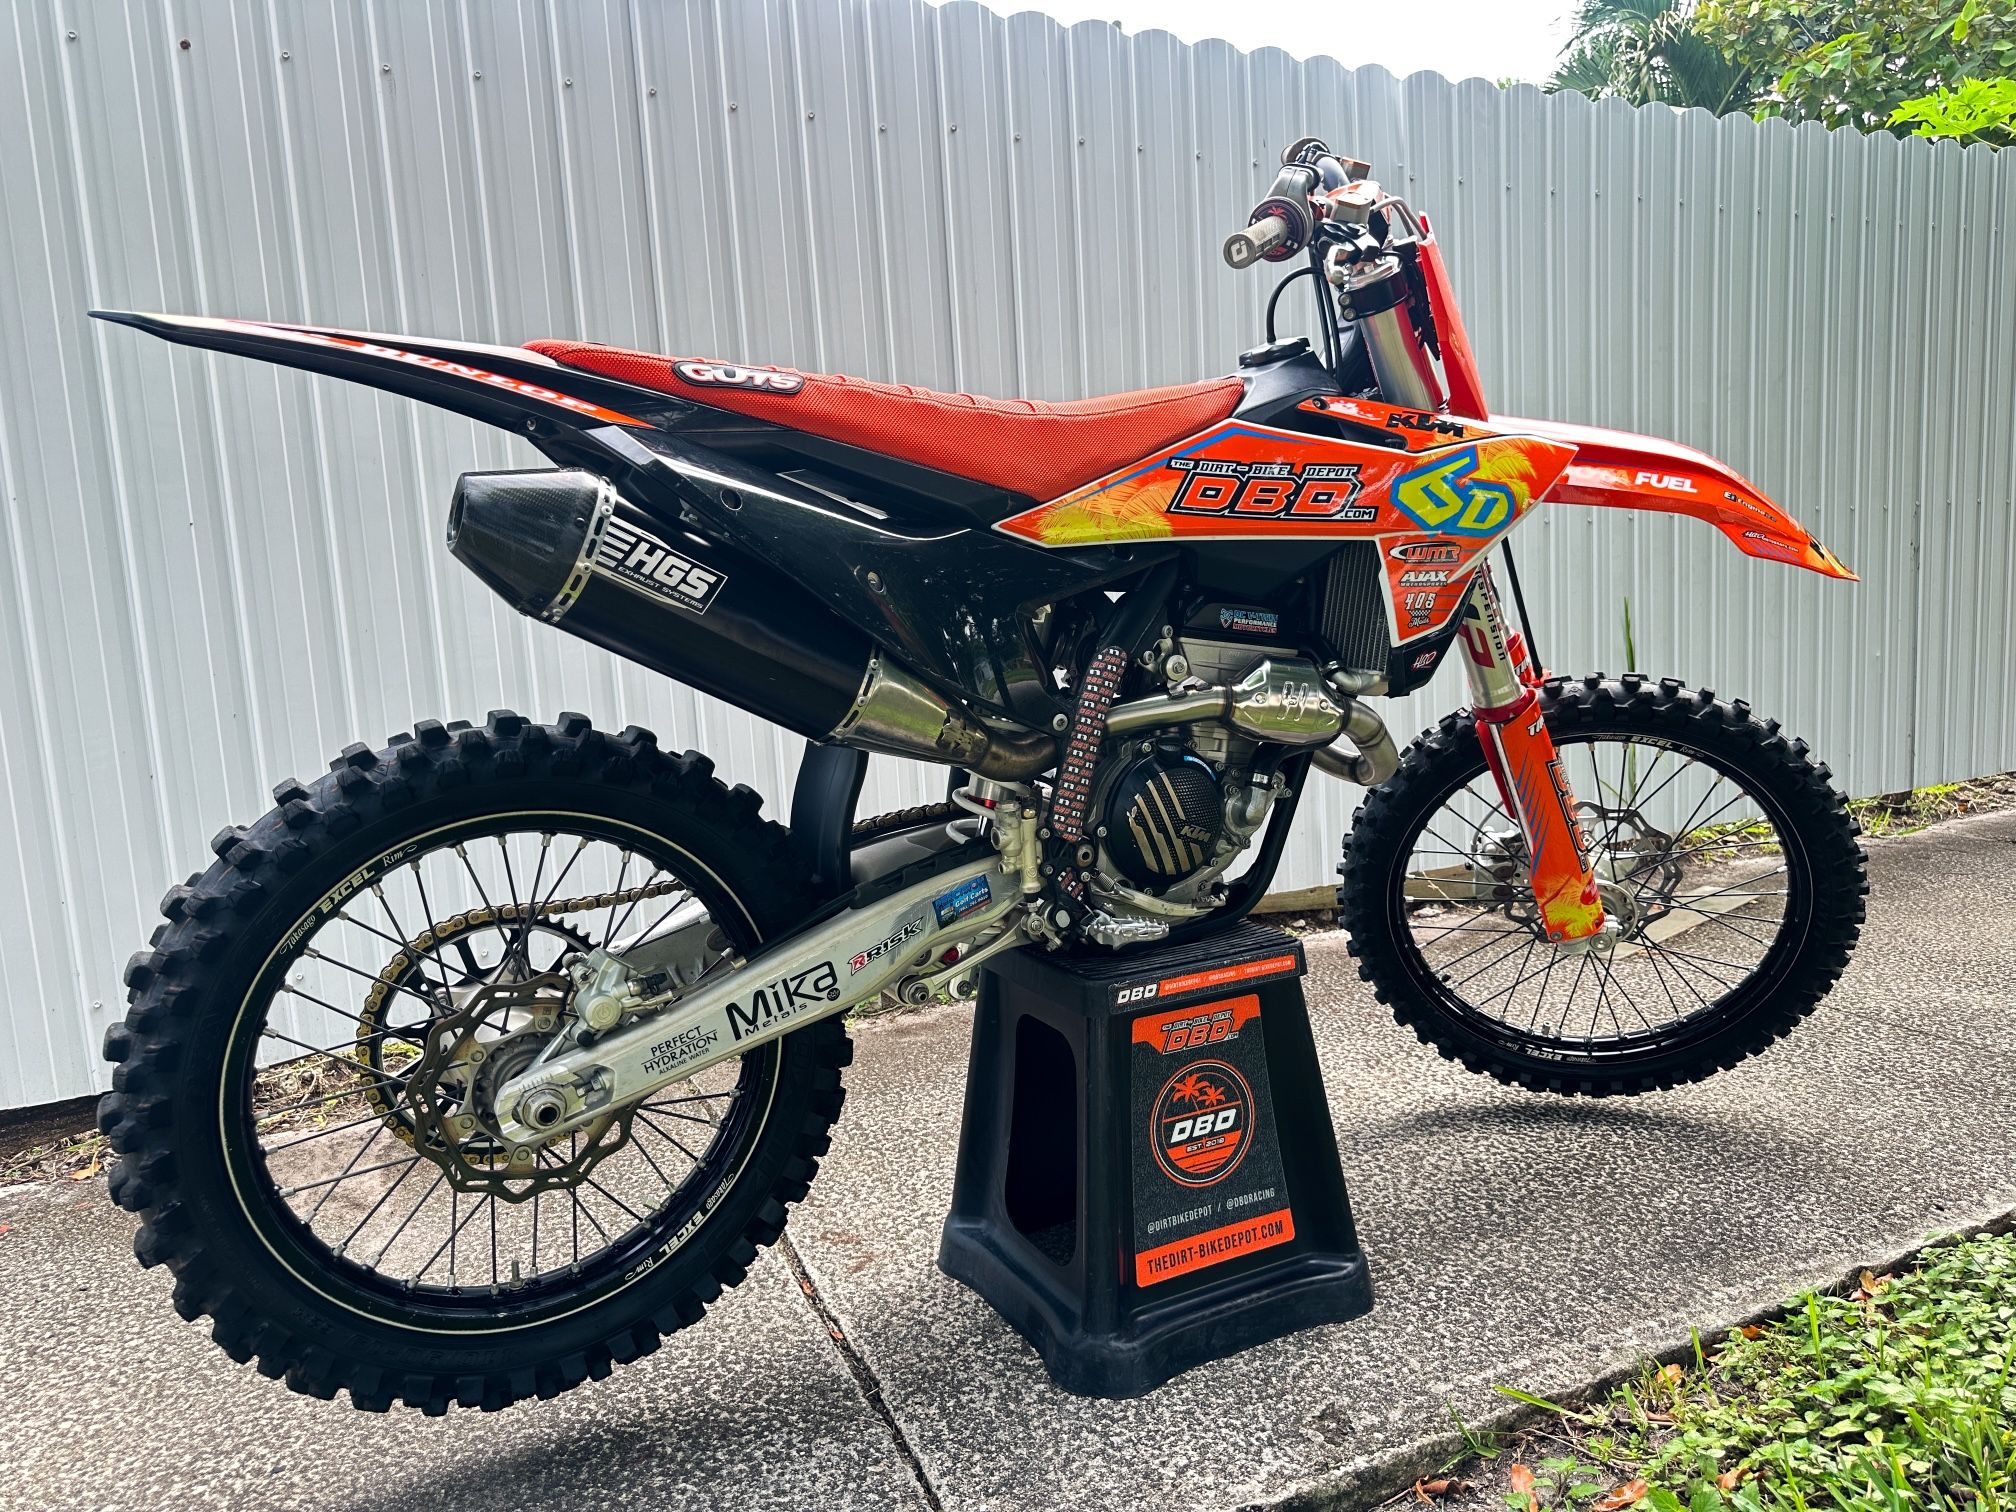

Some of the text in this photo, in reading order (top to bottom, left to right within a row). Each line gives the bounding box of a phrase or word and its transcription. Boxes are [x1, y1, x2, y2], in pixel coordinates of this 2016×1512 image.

[680, 364, 800, 390] GUTS
[1386, 411, 1464, 438] KTM
[1172, 460, 1192, 468] THE
[1199, 462, 1234, 473] DIRT
[1251, 465, 1290, 476] BIKE
[1306, 467, 1358, 477] DEPOT
[1634, 471, 1698, 493] FUEL
[1181, 475, 1354, 514] DBD
[1340, 509, 1374, 519] .COM
[624, 541, 717, 599] HGS
[1400, 571, 1450, 581] AJAX
[618, 566, 703, 609] EXHAUST SYSTEMS
[1405, 592, 1437, 609] 405
[1630, 735, 1674, 749] EXCEL
[1180, 825, 1212, 842] KTM
[283, 915, 316, 951] Takasago
[320, 868, 375, 914] EXCEL
[867, 916, 925, 961] RISK
[725, 961, 838, 1041] Mika
[1117, 984, 1158, 1004] DBD
[745, 1003, 808, 1036] Metals
[650, 1026, 701, 1057] PERFECT
[1166, 1020, 1231, 1051] DBD
[644, 1032, 718, 1074] HYDRATION
[659, 1048, 710, 1075] ALKALINE WATER
[1525, 1047, 1563, 1060] EXCEL
[1170, 1109, 1237, 1143] DBD
[1147, 1205, 1212, 1234] @DIRTBIKEDEPOT
[1226, 1188, 1275, 1210] @DBDRACING
[659, 1211, 705, 1255] EXCEL
[1147, 1220, 1284, 1274] THEDIRT-BIKEDEPOT.COM
